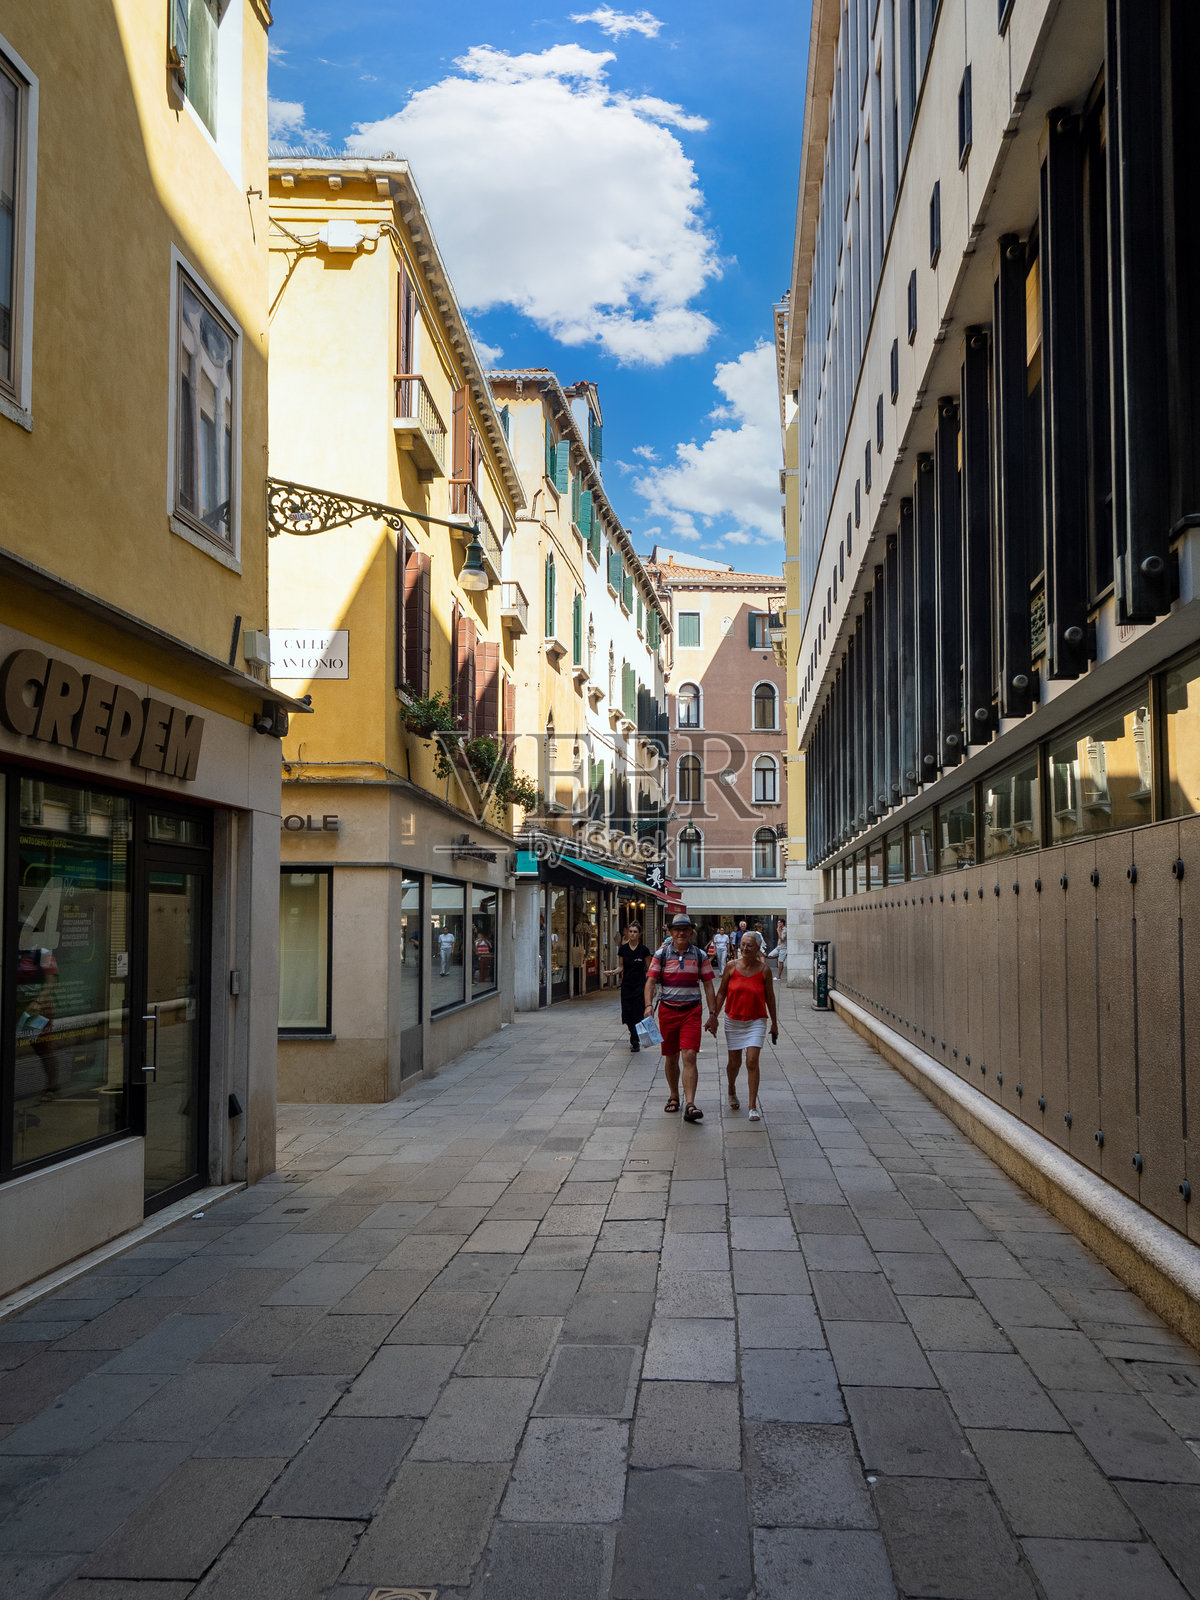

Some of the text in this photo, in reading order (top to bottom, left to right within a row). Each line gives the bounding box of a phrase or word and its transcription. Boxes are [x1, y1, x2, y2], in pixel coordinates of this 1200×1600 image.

[284, 639, 329, 650] CALLE
[282, 658, 344, 668] ANTONIO
[1, 648, 205, 781] CREDEM
[280, 814, 339, 832] OLE
